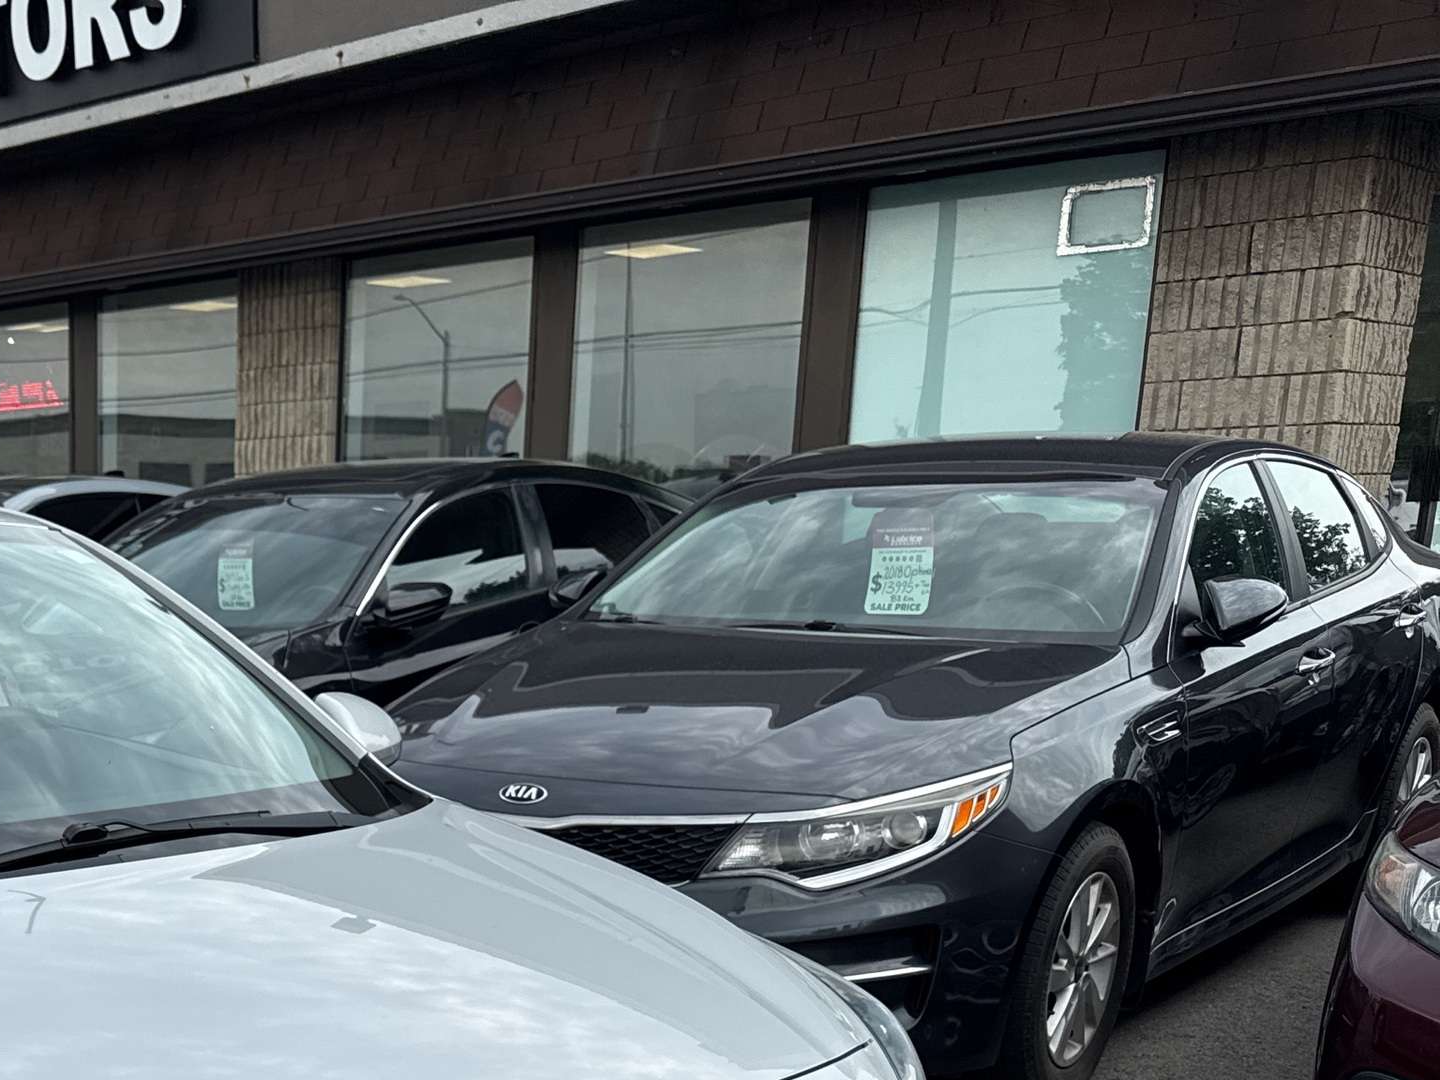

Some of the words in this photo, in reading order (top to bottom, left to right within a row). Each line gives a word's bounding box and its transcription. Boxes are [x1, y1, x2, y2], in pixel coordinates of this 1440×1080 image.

[870, 603, 893, 611] SALE
[895, 603, 921, 611] PRICE
[505, 785, 538, 800] KIA
